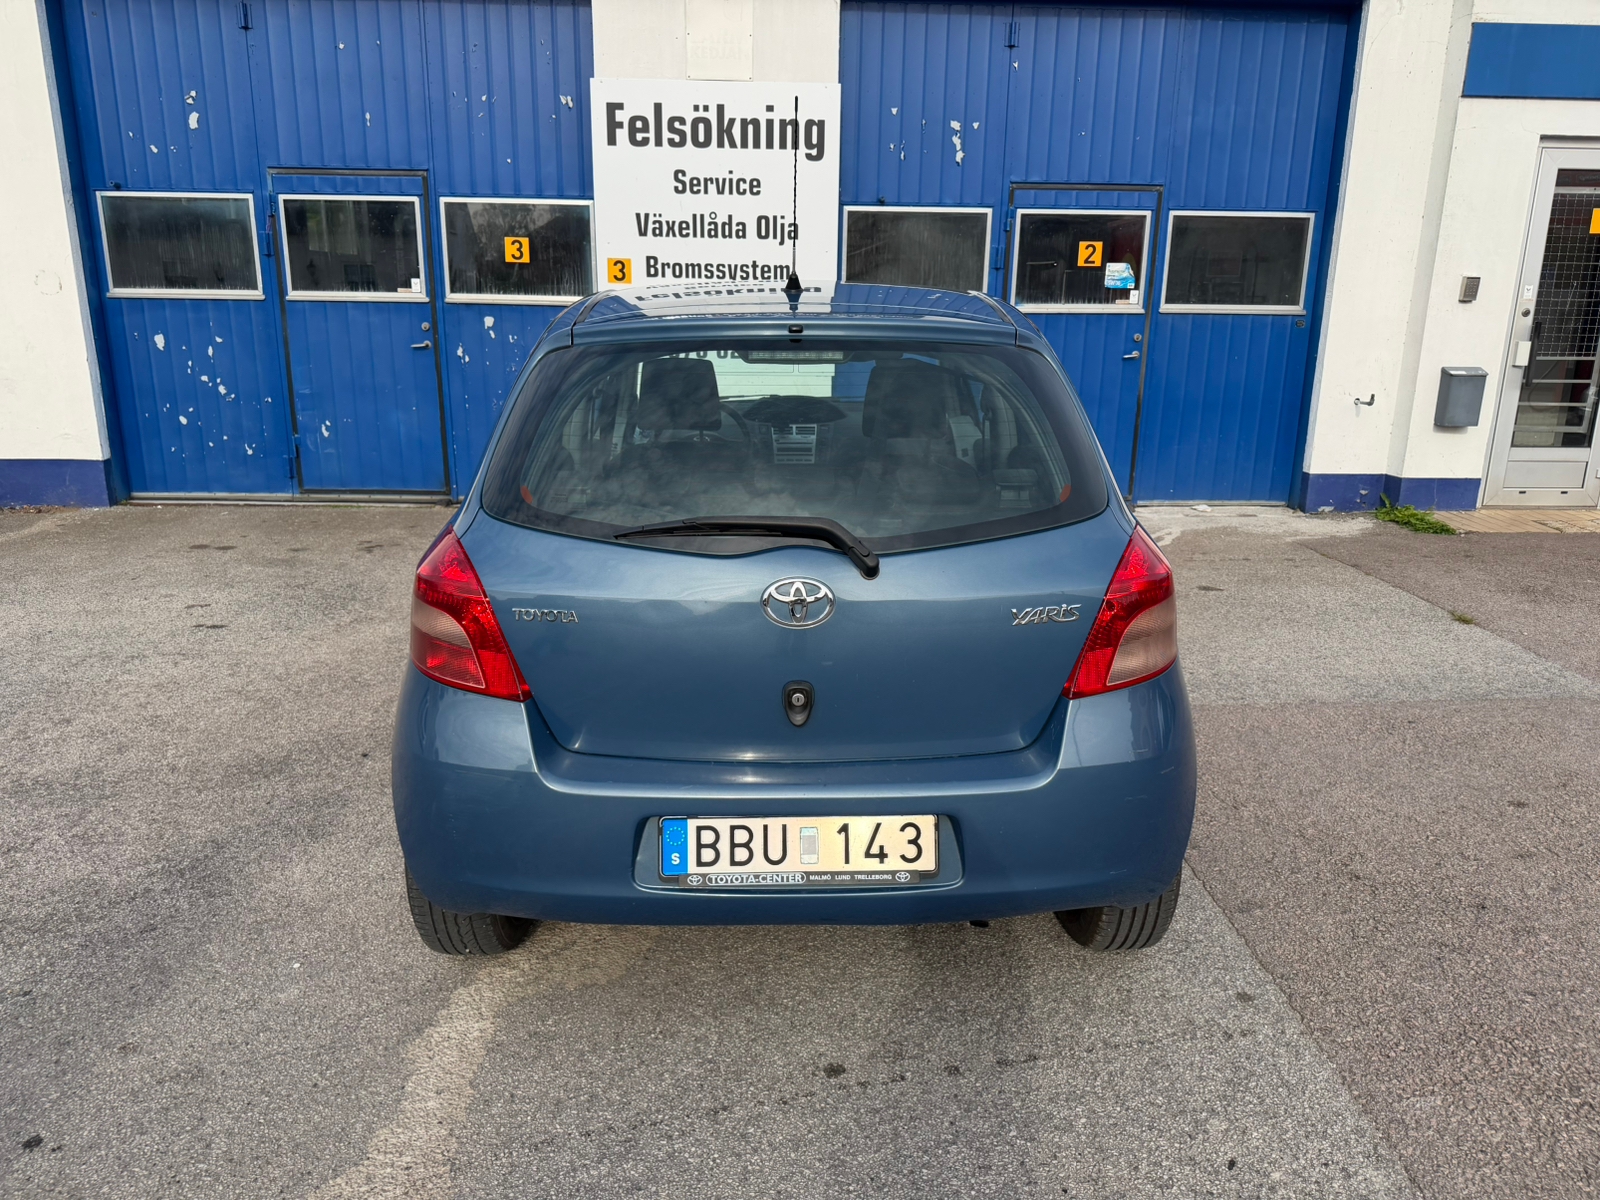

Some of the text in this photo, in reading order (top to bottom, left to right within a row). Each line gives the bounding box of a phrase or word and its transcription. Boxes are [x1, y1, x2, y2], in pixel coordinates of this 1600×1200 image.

[605, 102, 826, 162] Felsökning
[673, 168, 762, 196] Service
[635, 211, 799, 246] Växellåda Olja
[511, 239, 524, 261] 3
[1083, 243, 1097, 265] 2
[613, 260, 627, 282] 3
[645, 255, 791, 281] Bromssystem
[511, 607, 579, 624] TOYOTA
[695, 821, 923, 868] BBU 143
[671, 853, 680, 865] S
[709, 873, 803, 885] TOYOTA-CENTER
[809, 873, 832, 881] MALMÖ
[854, 873, 892, 881] TRELLEBORG
